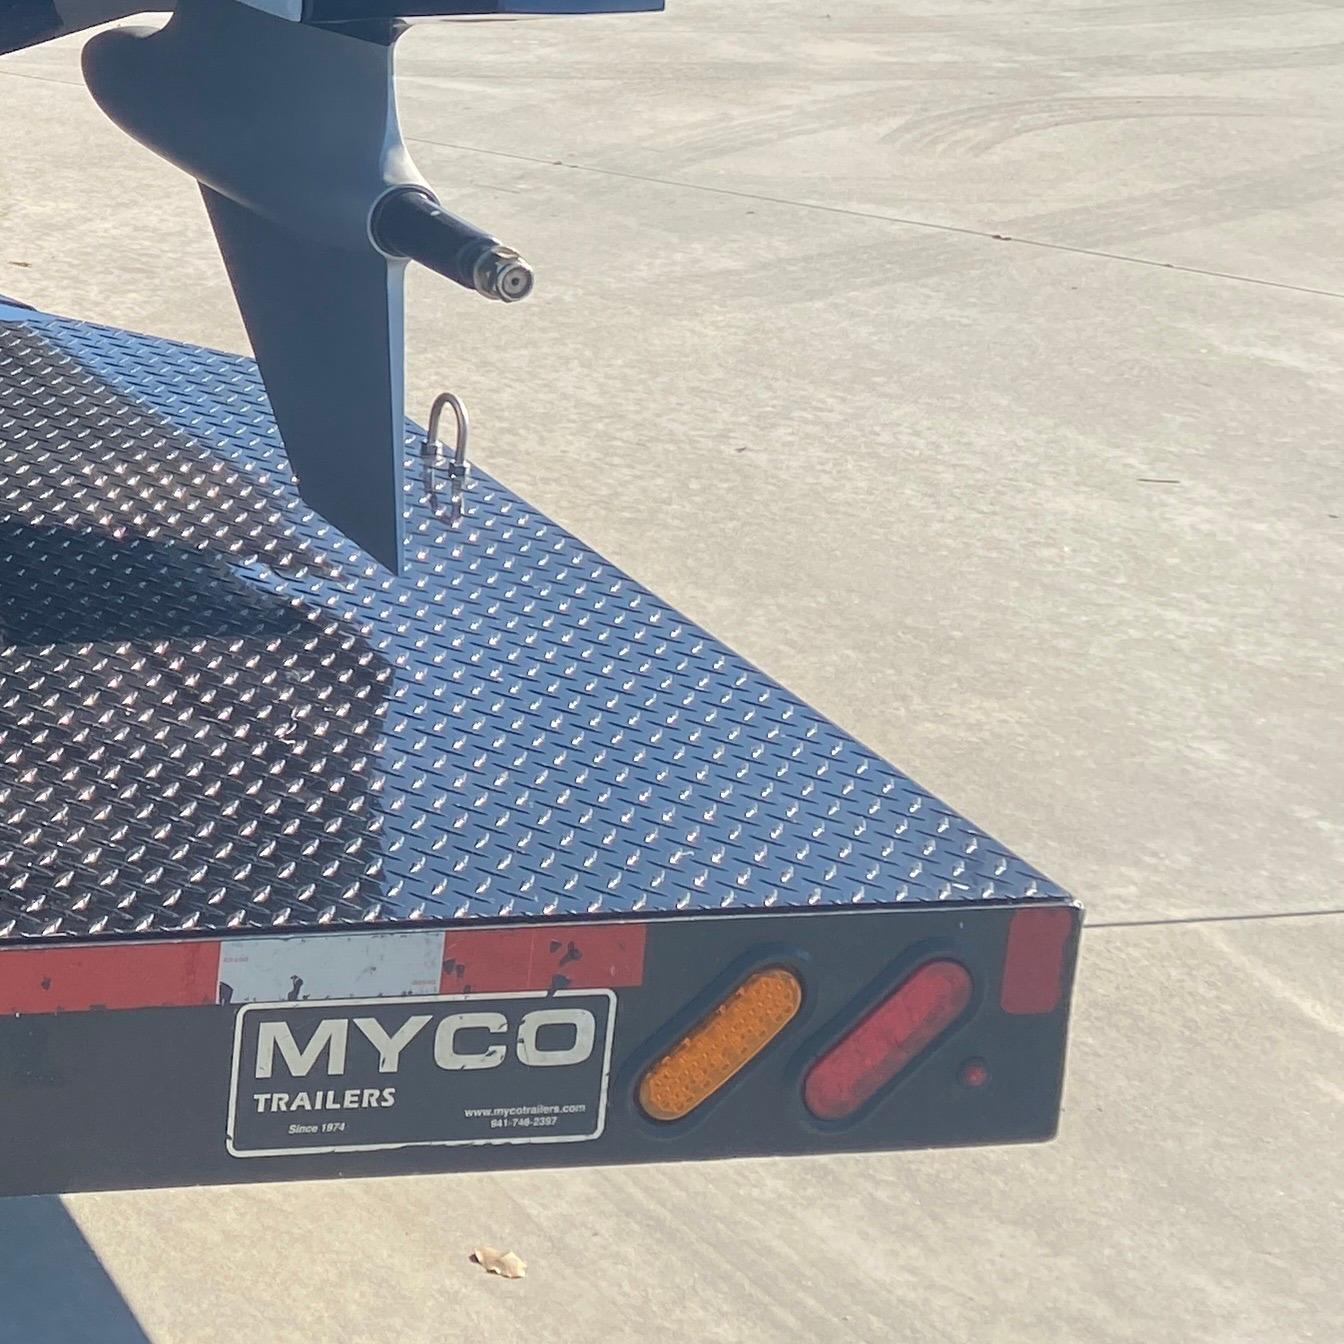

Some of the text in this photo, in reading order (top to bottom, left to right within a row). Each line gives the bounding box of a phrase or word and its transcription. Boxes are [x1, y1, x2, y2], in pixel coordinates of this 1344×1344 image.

[254, 1008, 596, 1080] MYCO
[253, 1087, 396, 1113] TRAILERS
[464, 1104, 586, 1117] www.mycotrailers.com
[288, 1124, 318, 1134] Since
